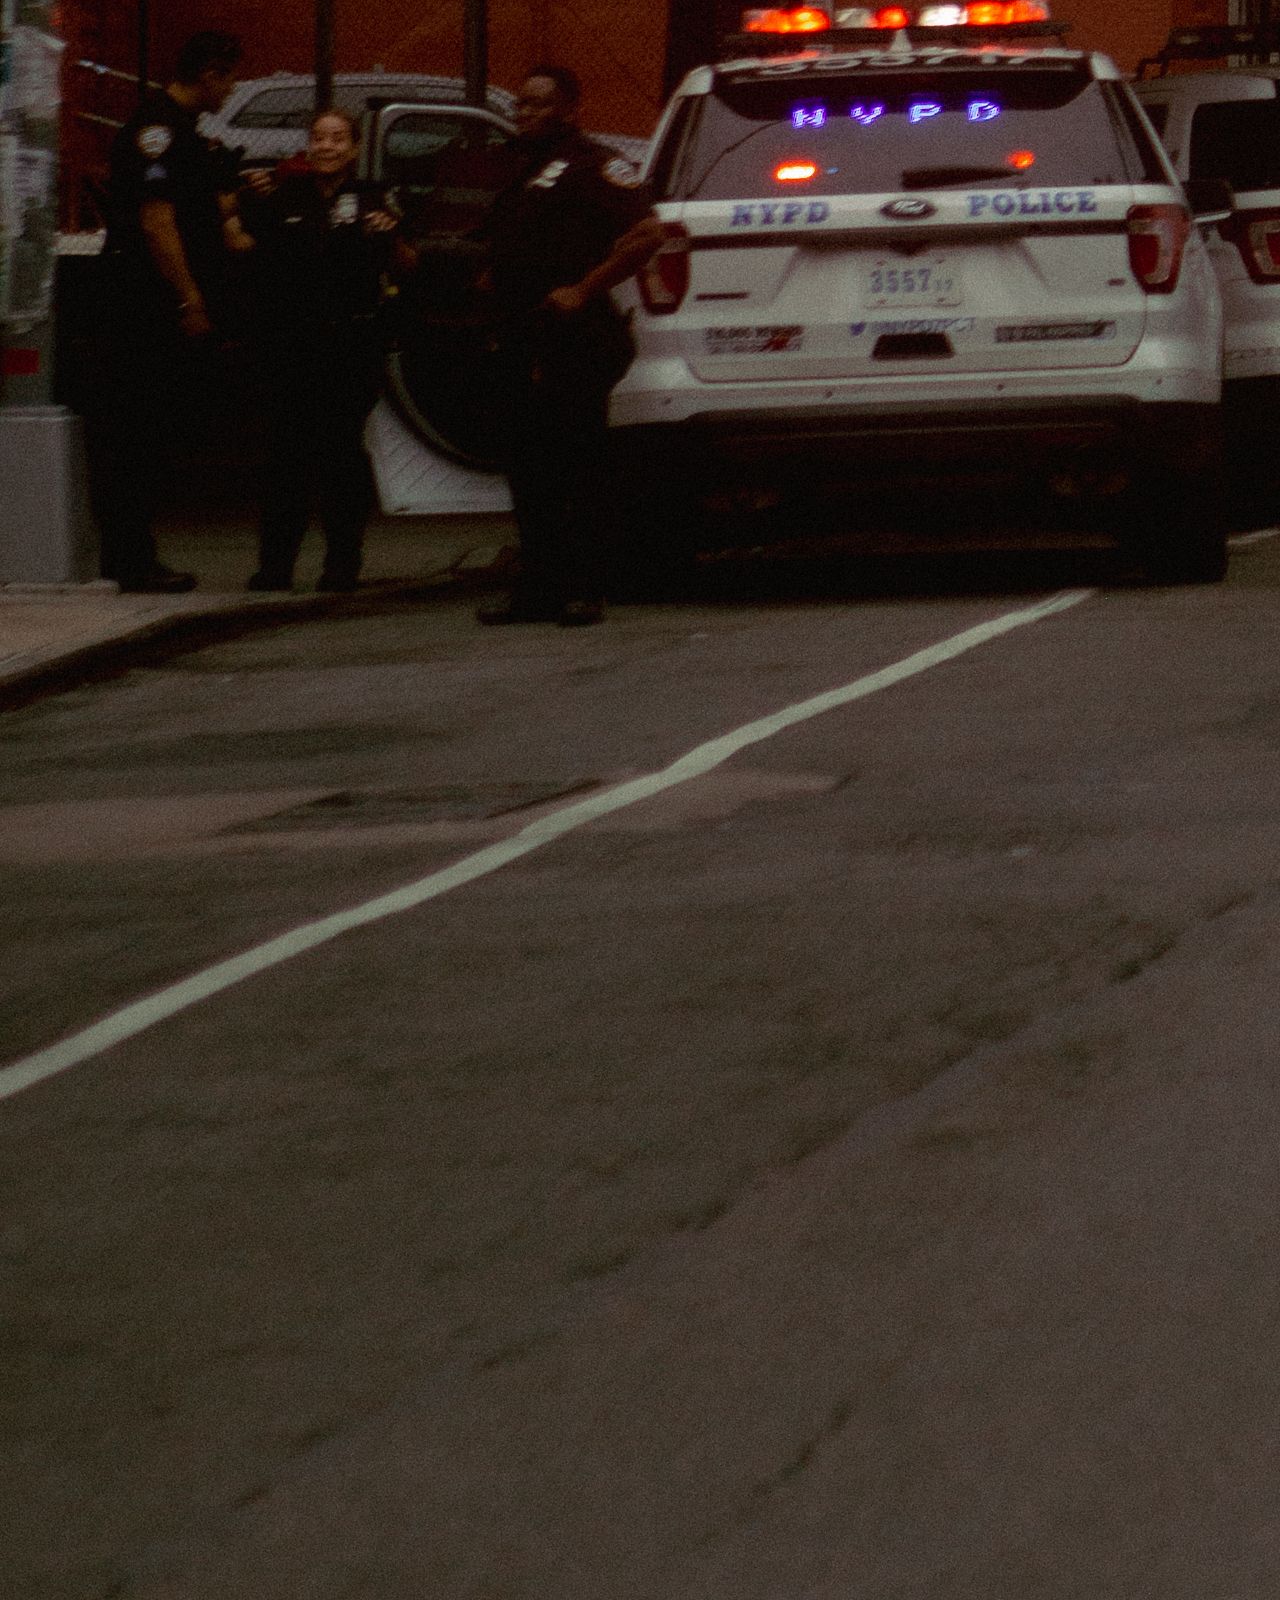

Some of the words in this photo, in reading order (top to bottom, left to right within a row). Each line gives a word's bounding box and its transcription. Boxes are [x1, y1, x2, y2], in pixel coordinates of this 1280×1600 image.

[730, 202, 830, 228] NYPD
[967, 189, 1099, 218] POLICE
[870, 268, 931, 294] 3557
